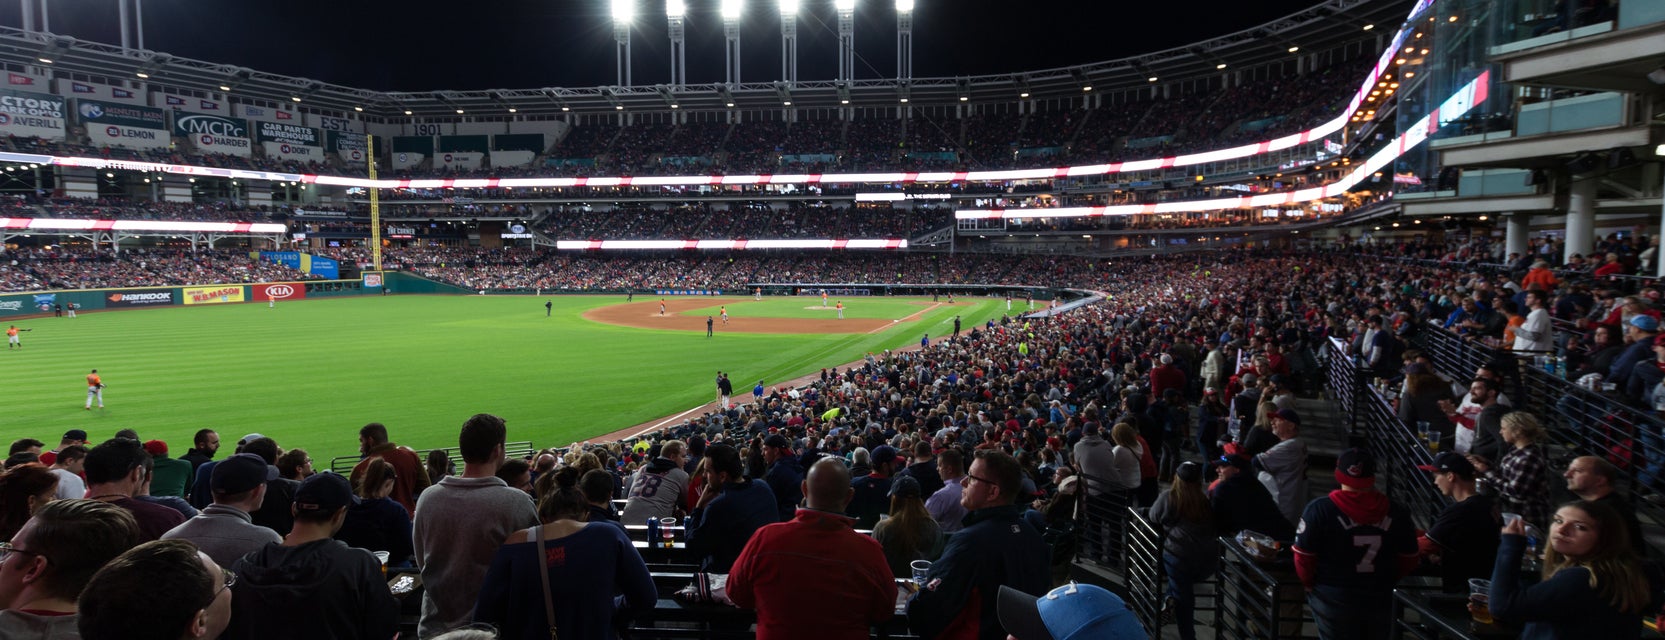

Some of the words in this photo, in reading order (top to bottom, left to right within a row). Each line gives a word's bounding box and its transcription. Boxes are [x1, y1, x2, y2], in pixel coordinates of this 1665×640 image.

[13, 116, 61, 129] AVERILL
[320, 117, 353, 132] EST.
[121, 129, 155, 139] LEMON
[261, 129, 315, 141] WAREHOUSE
[263, 123, 282, 131] CAR
[284, 125, 312, 135] PARTS
[414, 124, 442, 136] 1901
[214, 137, 248, 147] HARDER
[292, 146, 310, 155] DOBY
[270, 287, 289, 295] KIA
[629, 475, 662, 497] 28
[1353, 535, 1383, 574] 7
